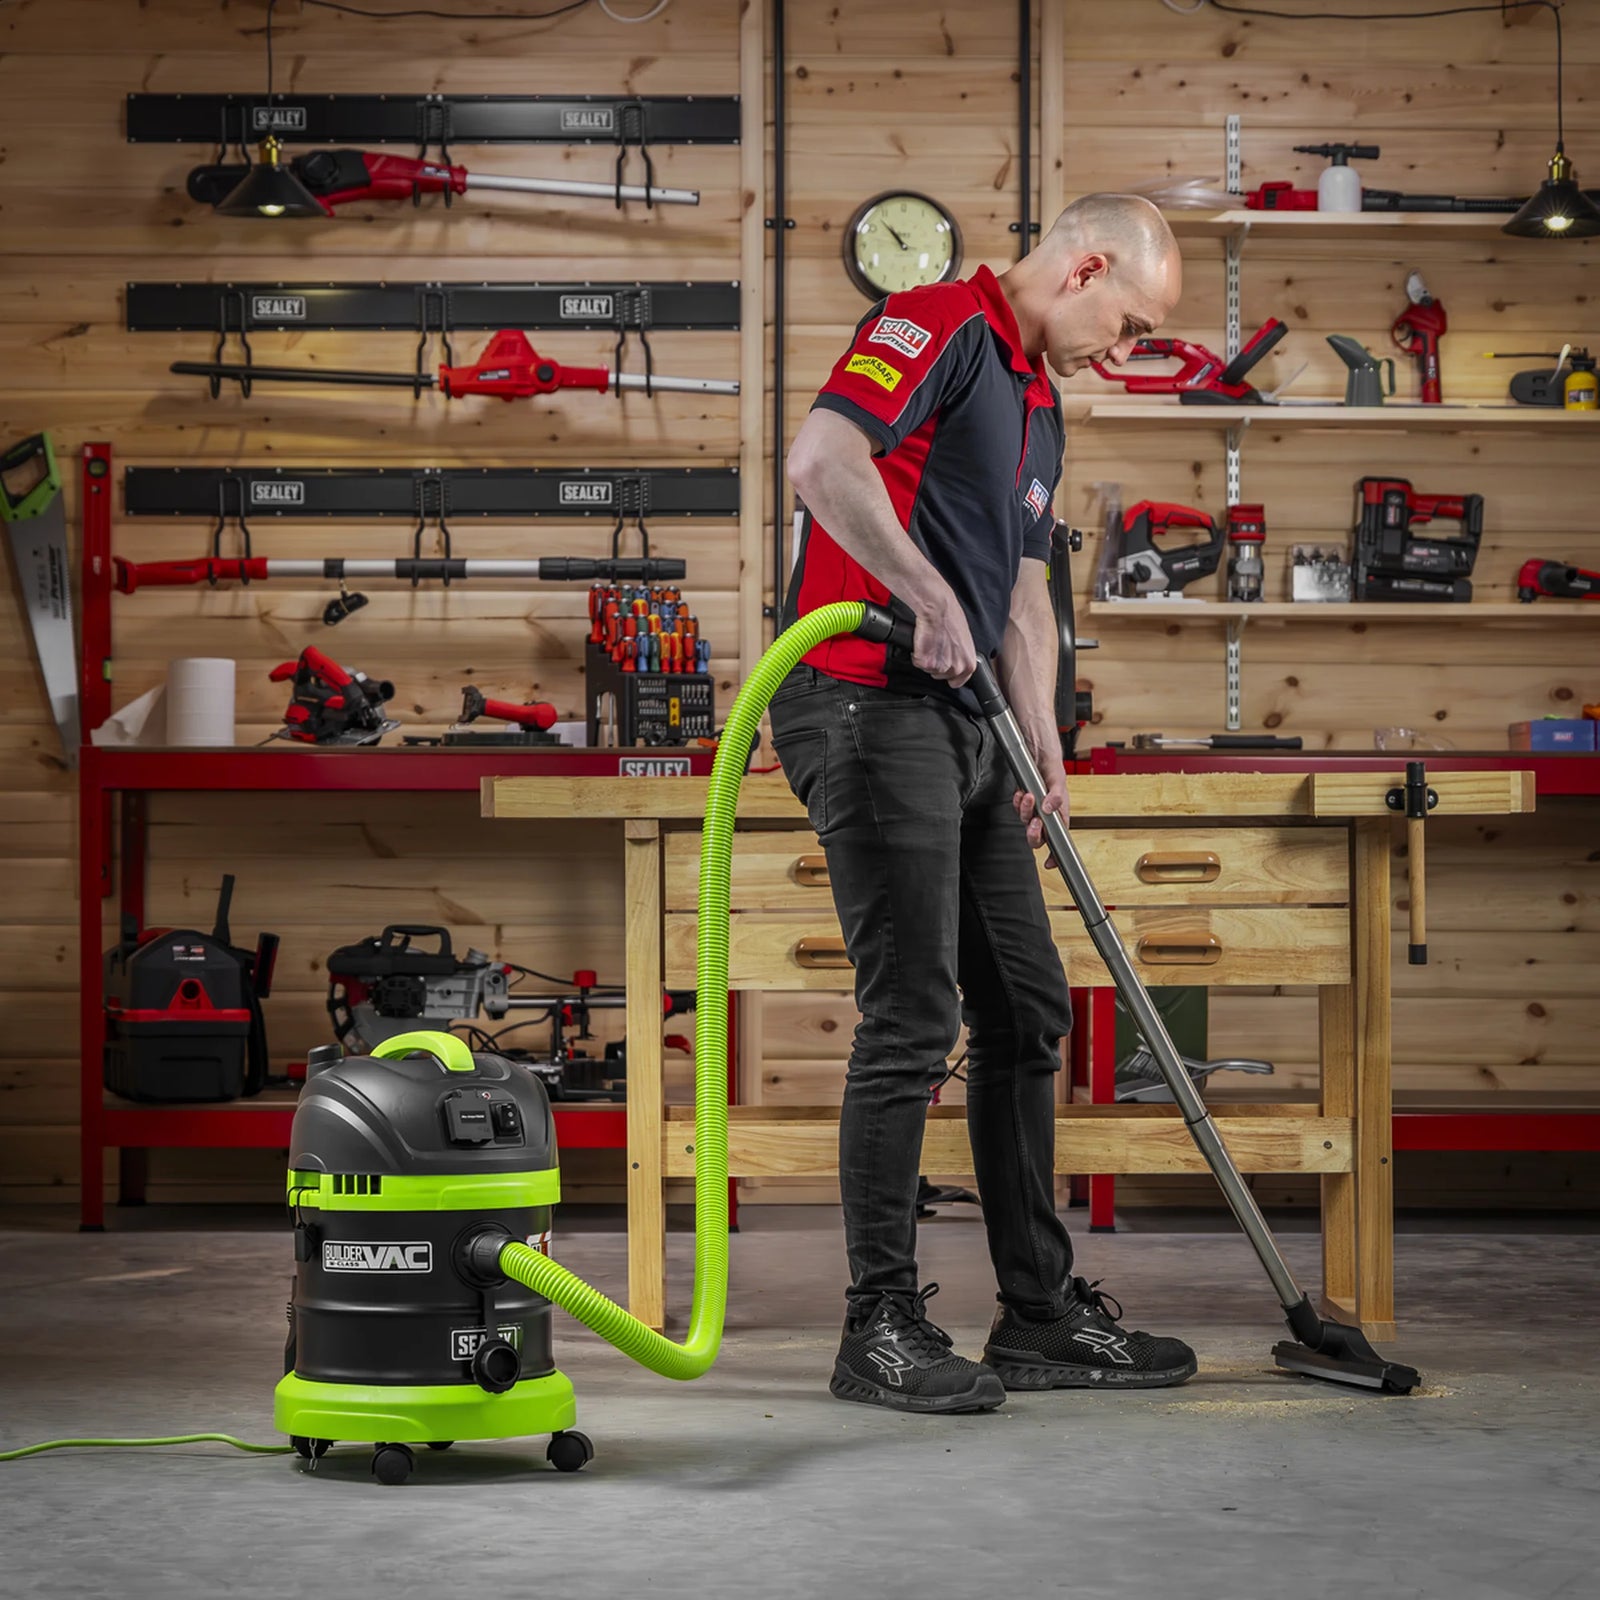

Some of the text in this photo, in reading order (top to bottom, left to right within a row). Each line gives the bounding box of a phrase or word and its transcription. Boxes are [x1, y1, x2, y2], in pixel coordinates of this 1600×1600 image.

[565, 111, 608, 126] SEALEY
[257, 299, 301, 314] SEALEY
[564, 298, 608, 314] SEALEY
[879, 320, 924, 345] SEALEY
[870, 334, 916, 355] Premier
[851, 358, 895, 384] WORKSAFE
[255, 484, 300, 499] SEALEY
[564, 485, 608, 500] SEALEY
[625, 762, 684, 777] SEALEY
[324, 1244, 429, 1269] BUILDER VAC
